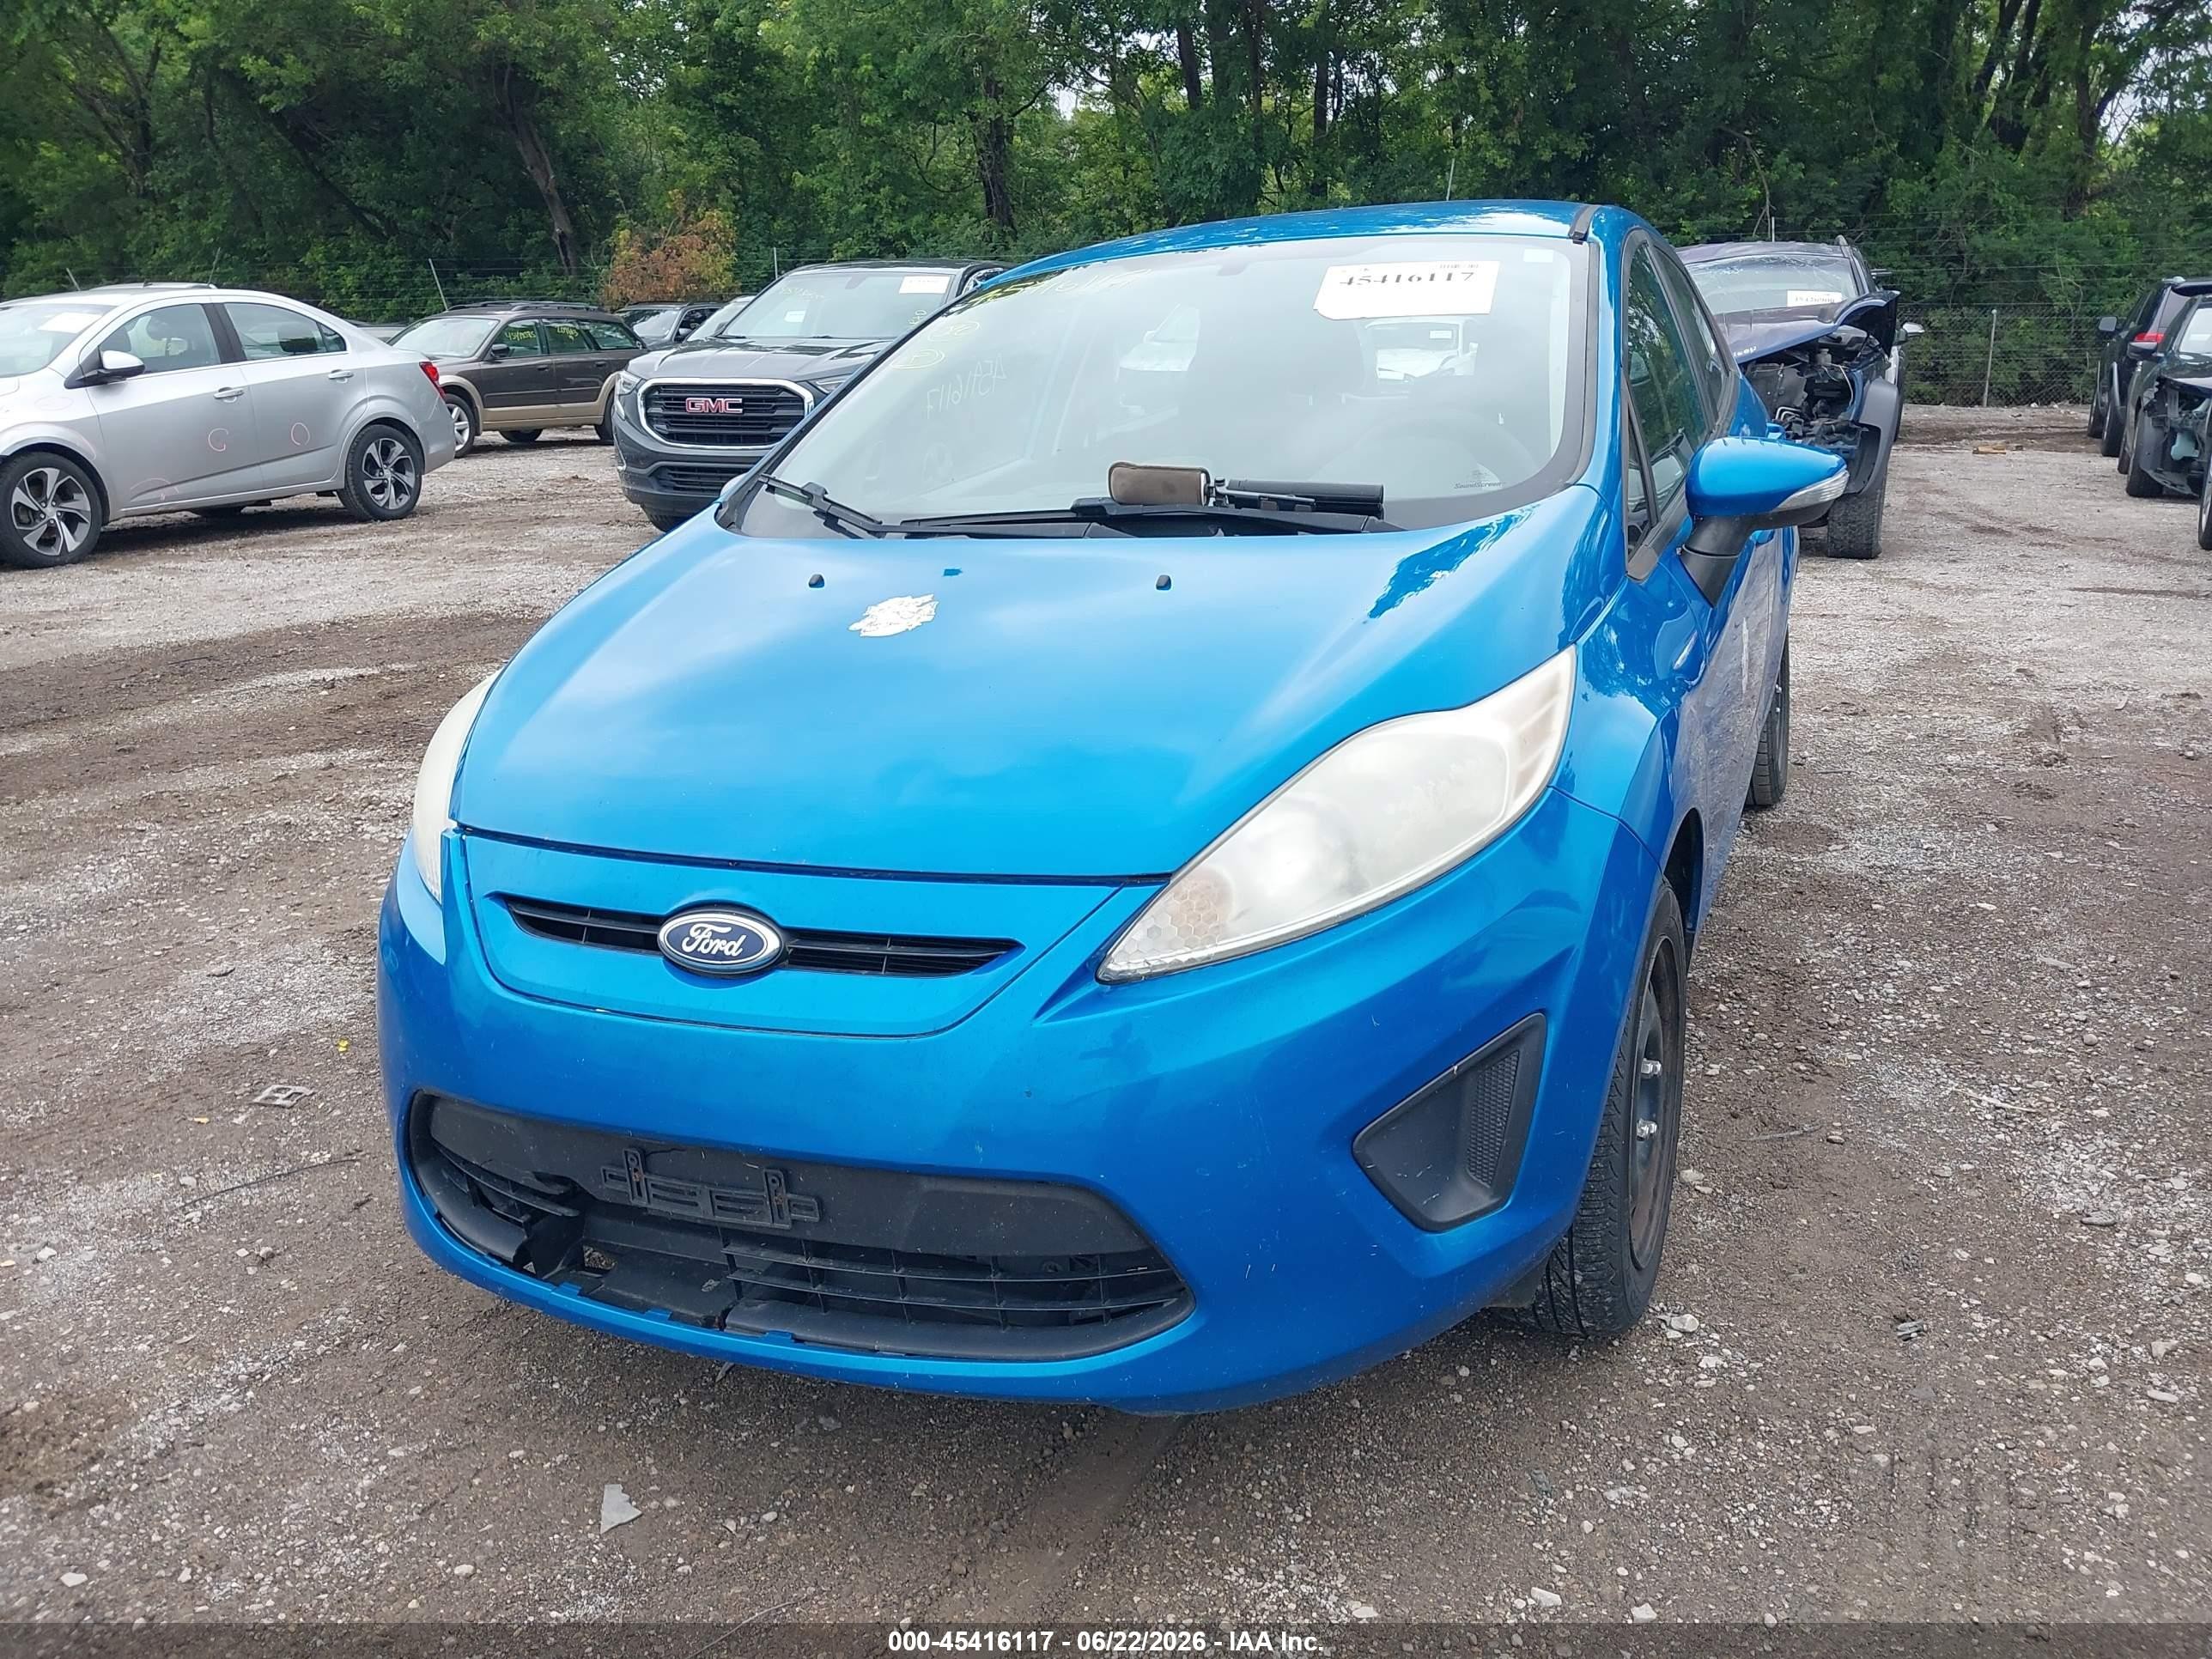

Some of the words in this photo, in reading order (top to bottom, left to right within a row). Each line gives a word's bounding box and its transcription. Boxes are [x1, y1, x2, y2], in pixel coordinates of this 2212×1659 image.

[1340, 271, 1474, 285] 45416117
[685, 397, 743, 413] GMC
[682, 922, 747, 957] Ford
